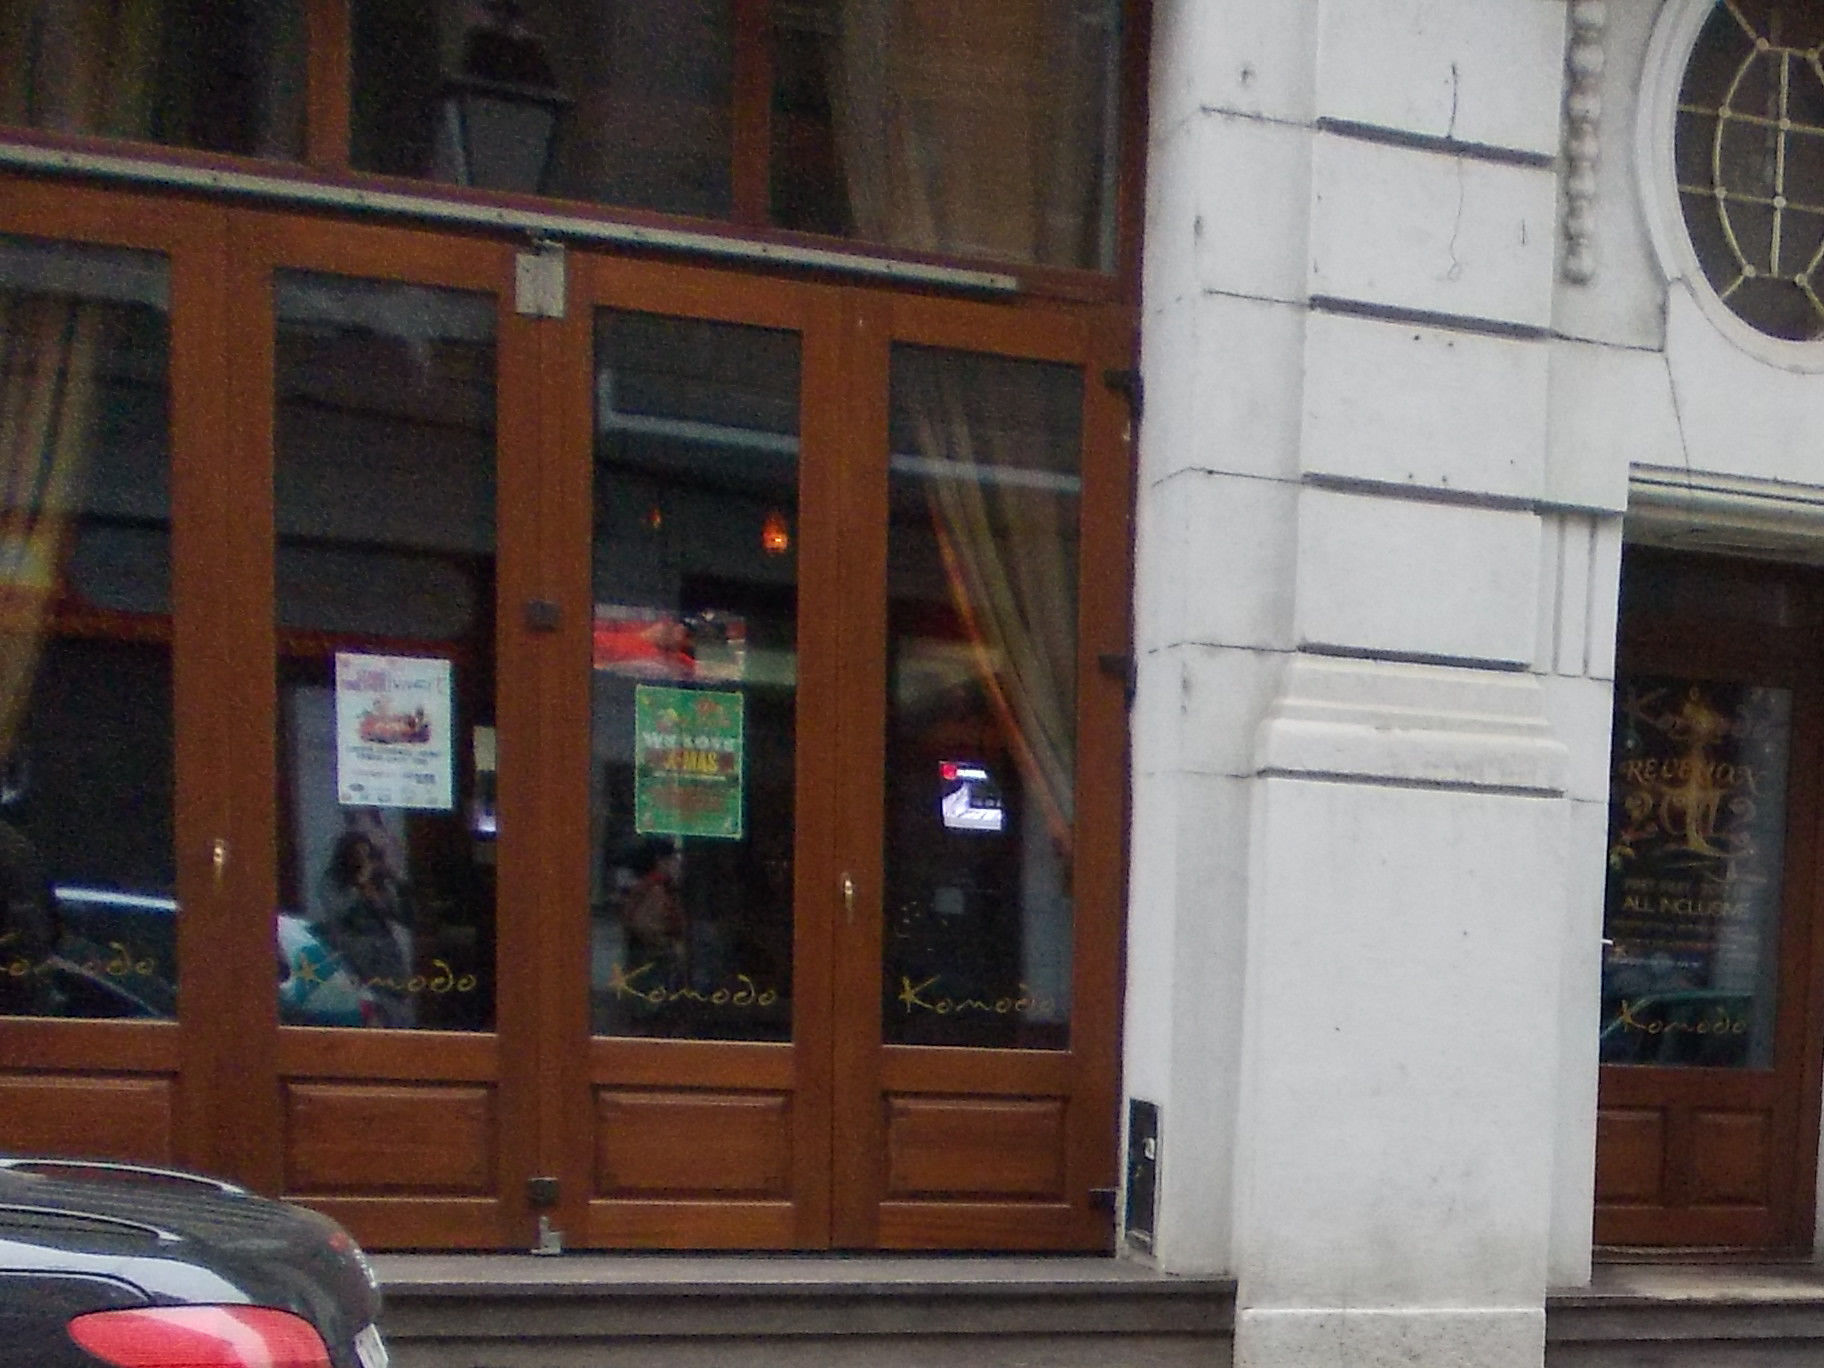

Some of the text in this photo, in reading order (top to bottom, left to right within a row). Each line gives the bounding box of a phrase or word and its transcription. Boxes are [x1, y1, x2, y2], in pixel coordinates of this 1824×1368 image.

[609, 962, 776, 1006] Komodo
[898, 975, 1055, 1014] Komodo
[1620, 1000, 1746, 1034] Komodo
